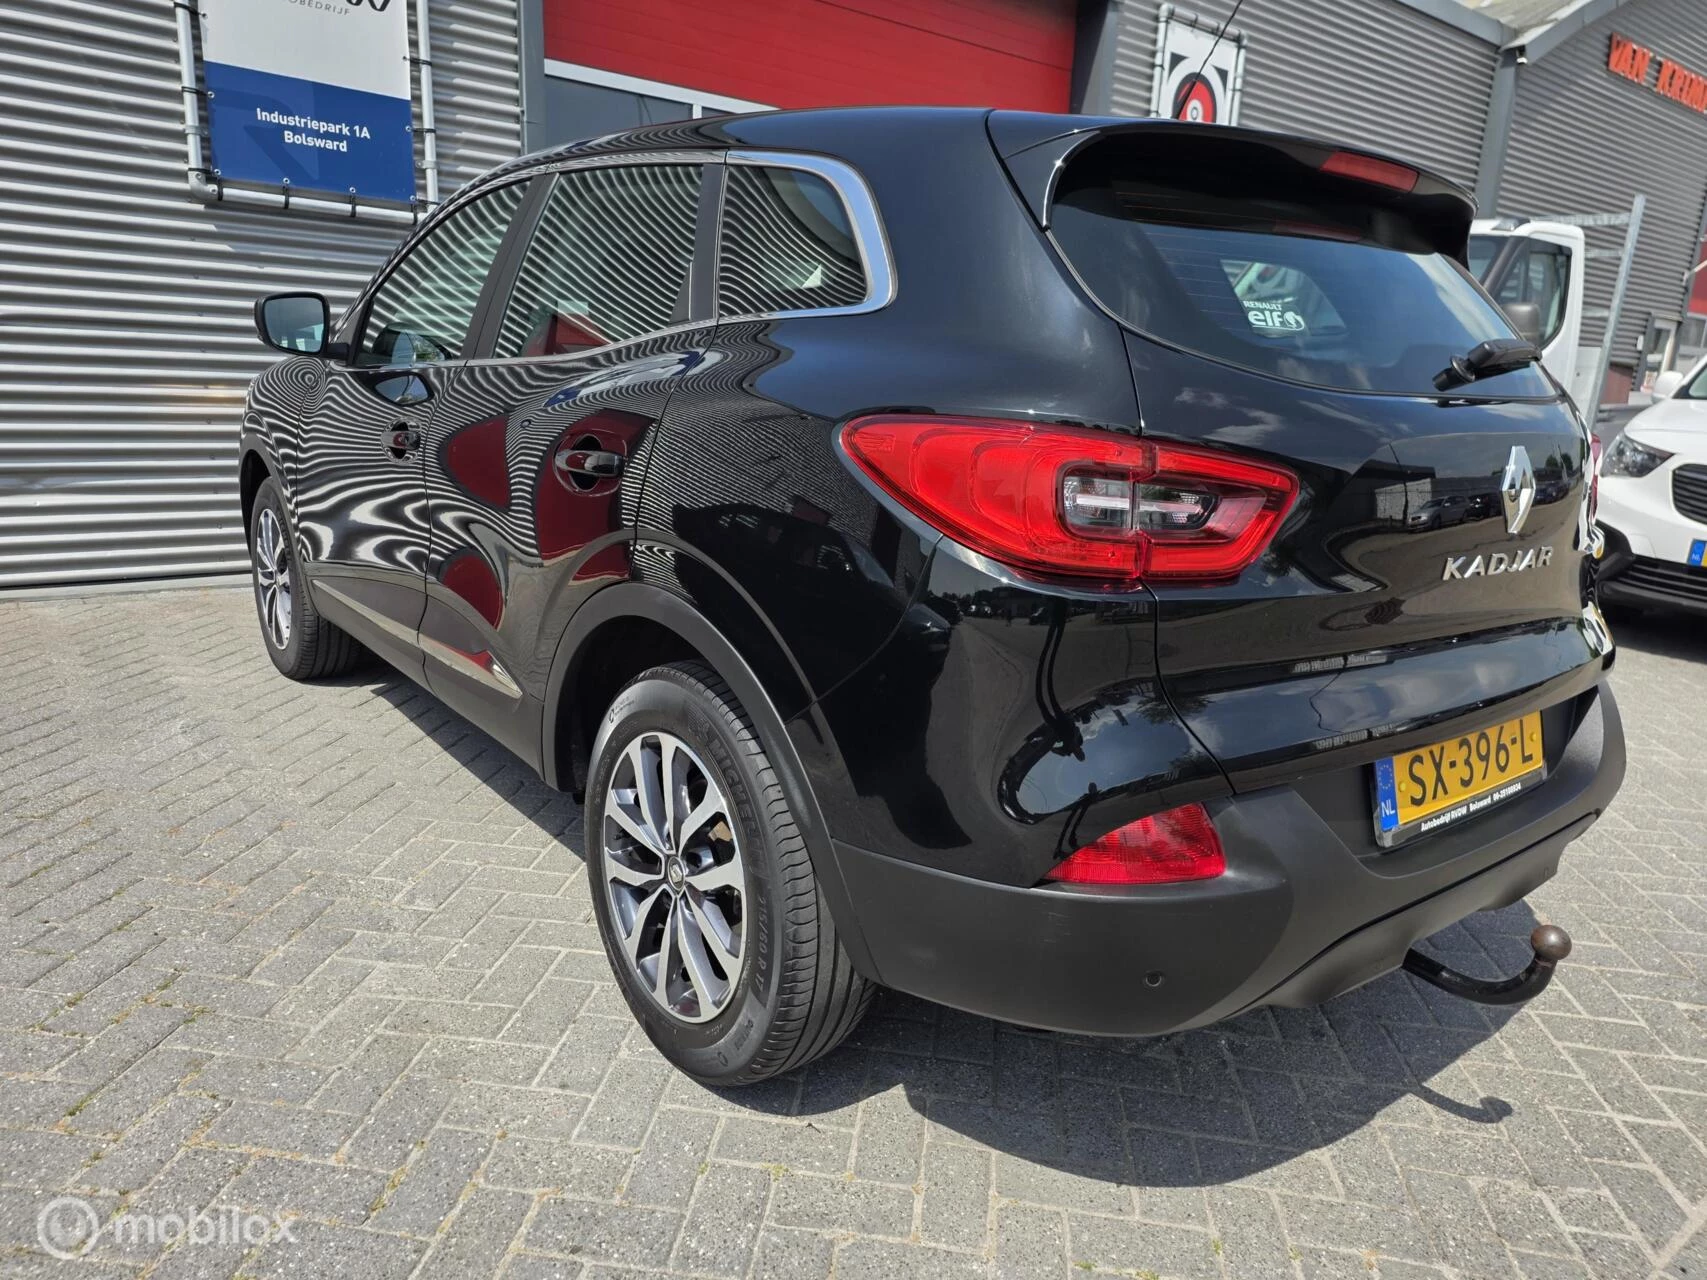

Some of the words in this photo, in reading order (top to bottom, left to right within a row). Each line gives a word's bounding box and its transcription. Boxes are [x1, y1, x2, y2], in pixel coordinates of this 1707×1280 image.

[1608, 33, 1652, 85] VAN
[256, 108, 350, 136] Industriepark
[353, 125, 371, 140] 1A
[284, 131, 348, 152] Bolsward
[1243, 300, 1282, 310] RENAULT
[1247, 310, 1284, 327] elf
[1442, 546, 1553, 581] KADJAR
[1408, 719, 1534, 807] SX-396-L
[1381, 801, 1396, 817] NL
